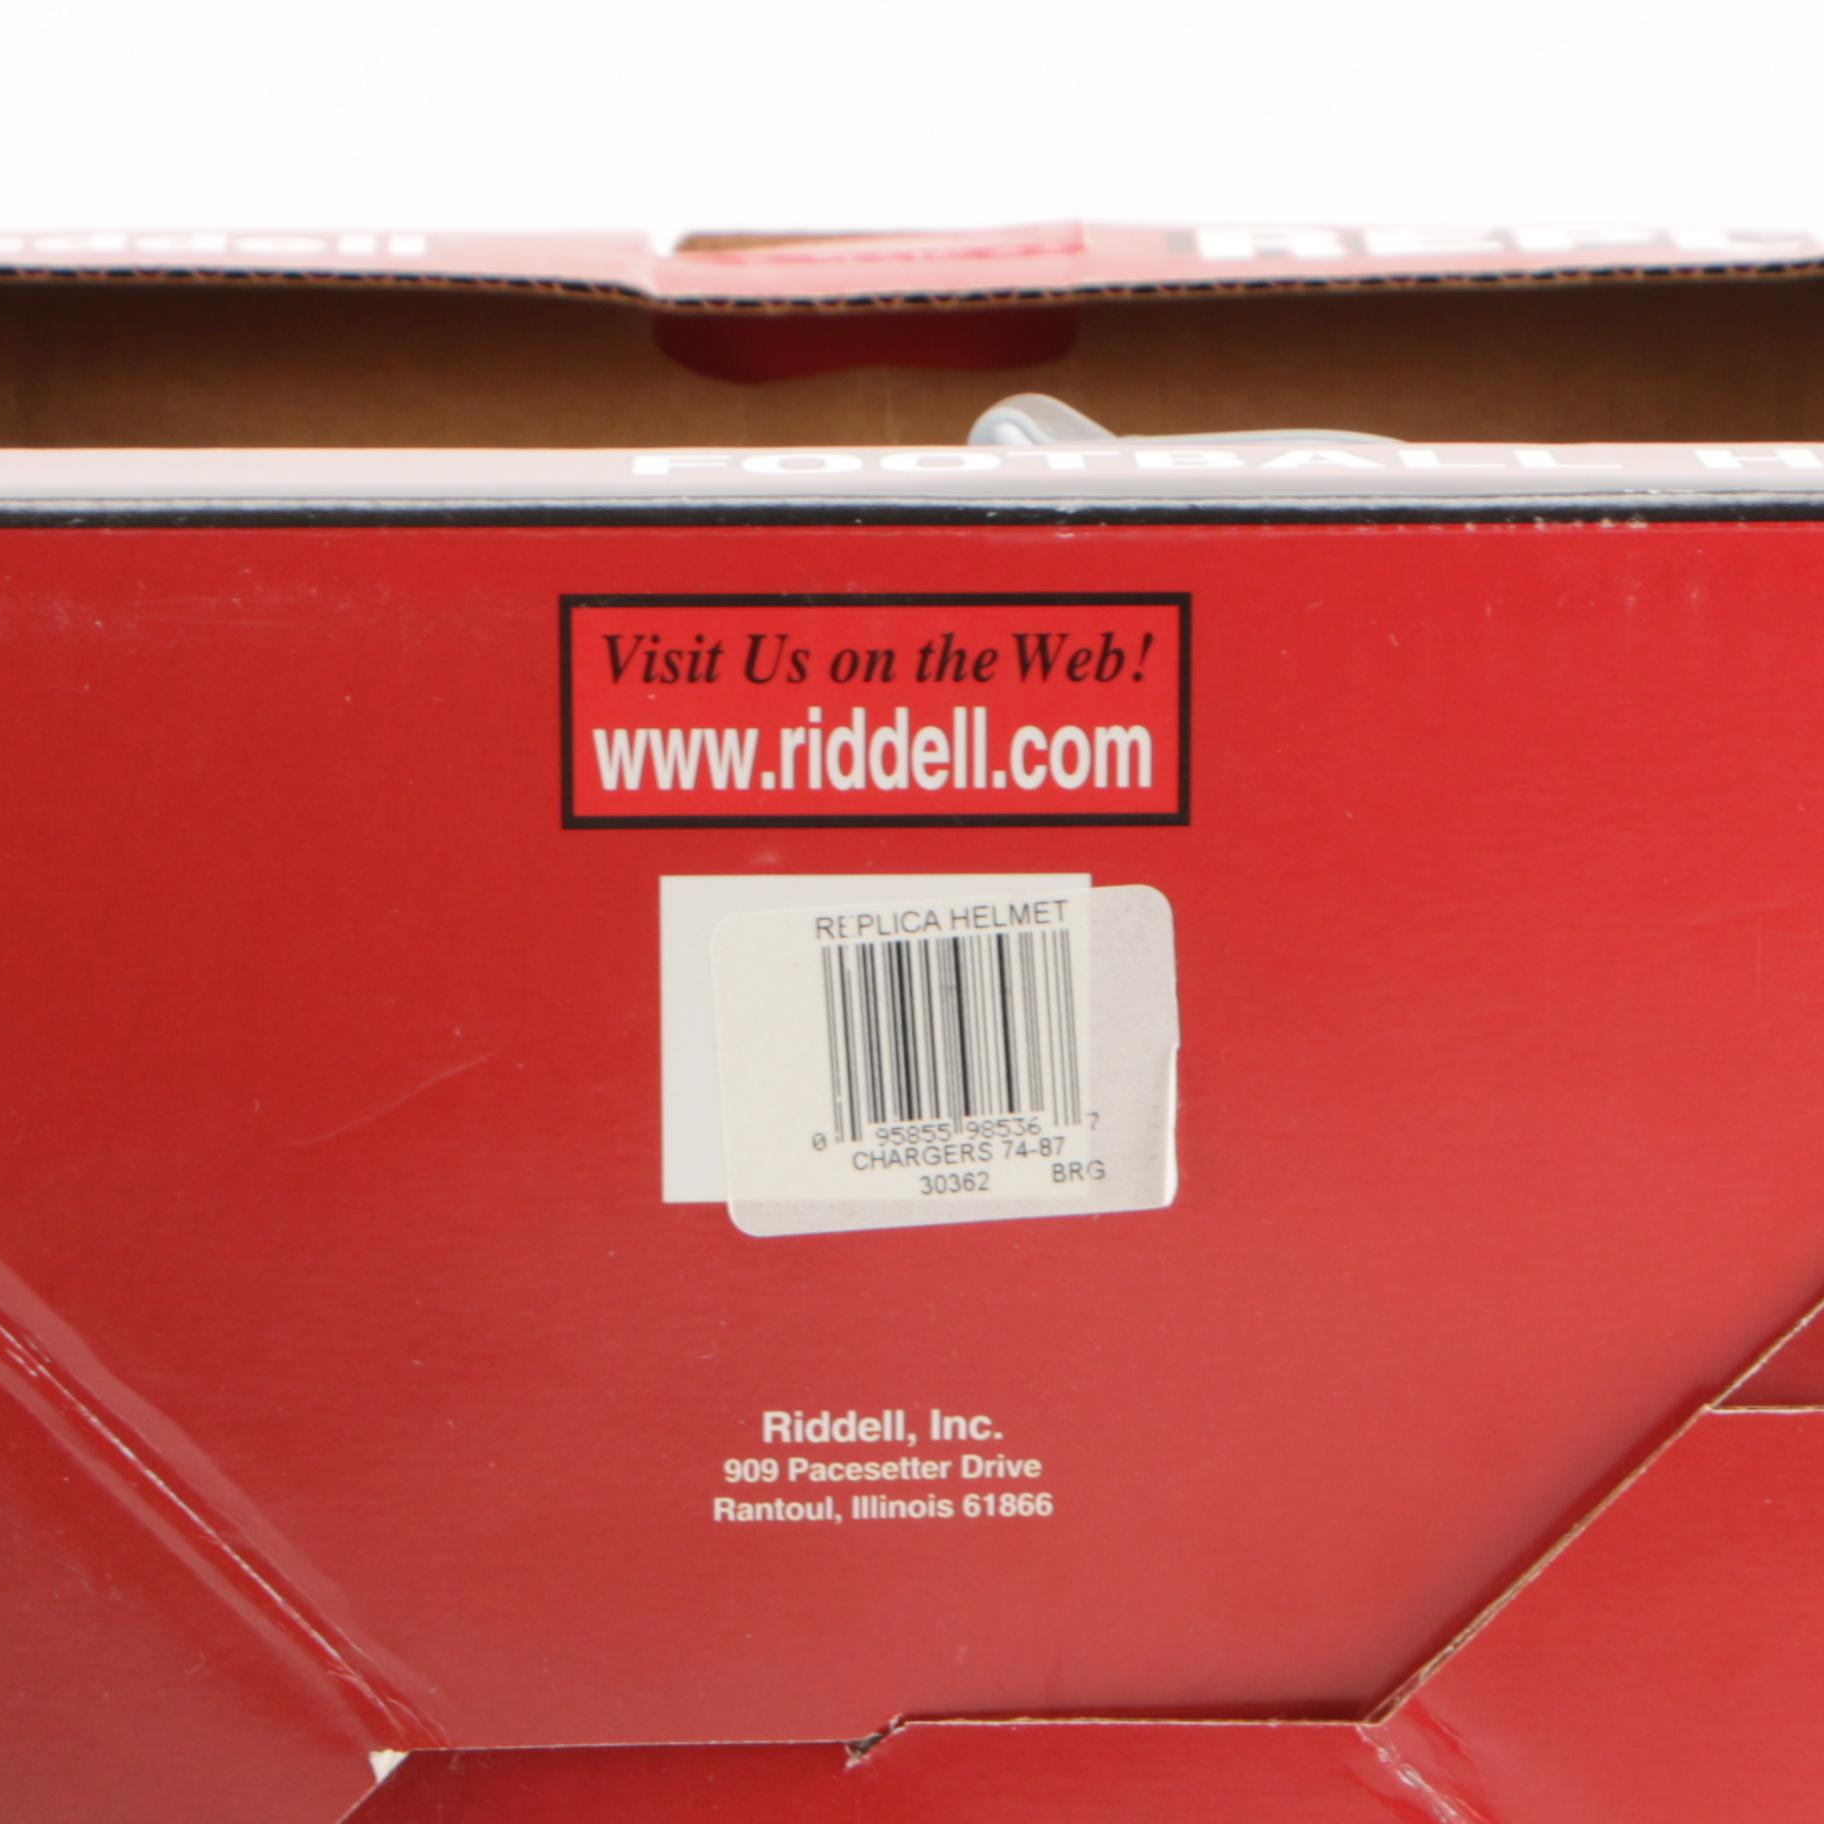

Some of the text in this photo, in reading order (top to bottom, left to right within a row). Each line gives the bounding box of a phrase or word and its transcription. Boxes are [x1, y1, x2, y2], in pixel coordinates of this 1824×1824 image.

[628, 449, 1622, 476] FOOTBALL
[601, 631, 1154, 684] Visit Us on the Web!
[592, 707, 1153, 791] www.riddell.com
[815, 900, 1068, 940] REPLICA HELMET
[876, 1123, 952, 1146] 95855
[1086, 1112, 1100, 1131] 7
[852, 1136, 1066, 1170] CHARGERS 74-87
[920, 1159, 1106, 1195] 30362 BRG
[762, 1408, 1004, 1447] Riddell, Inc.
[723, 1454, 1042, 1482] 909 Pacesetter Drive
[712, 1492, 1054, 1524] Rantoul, Illinois 61866
